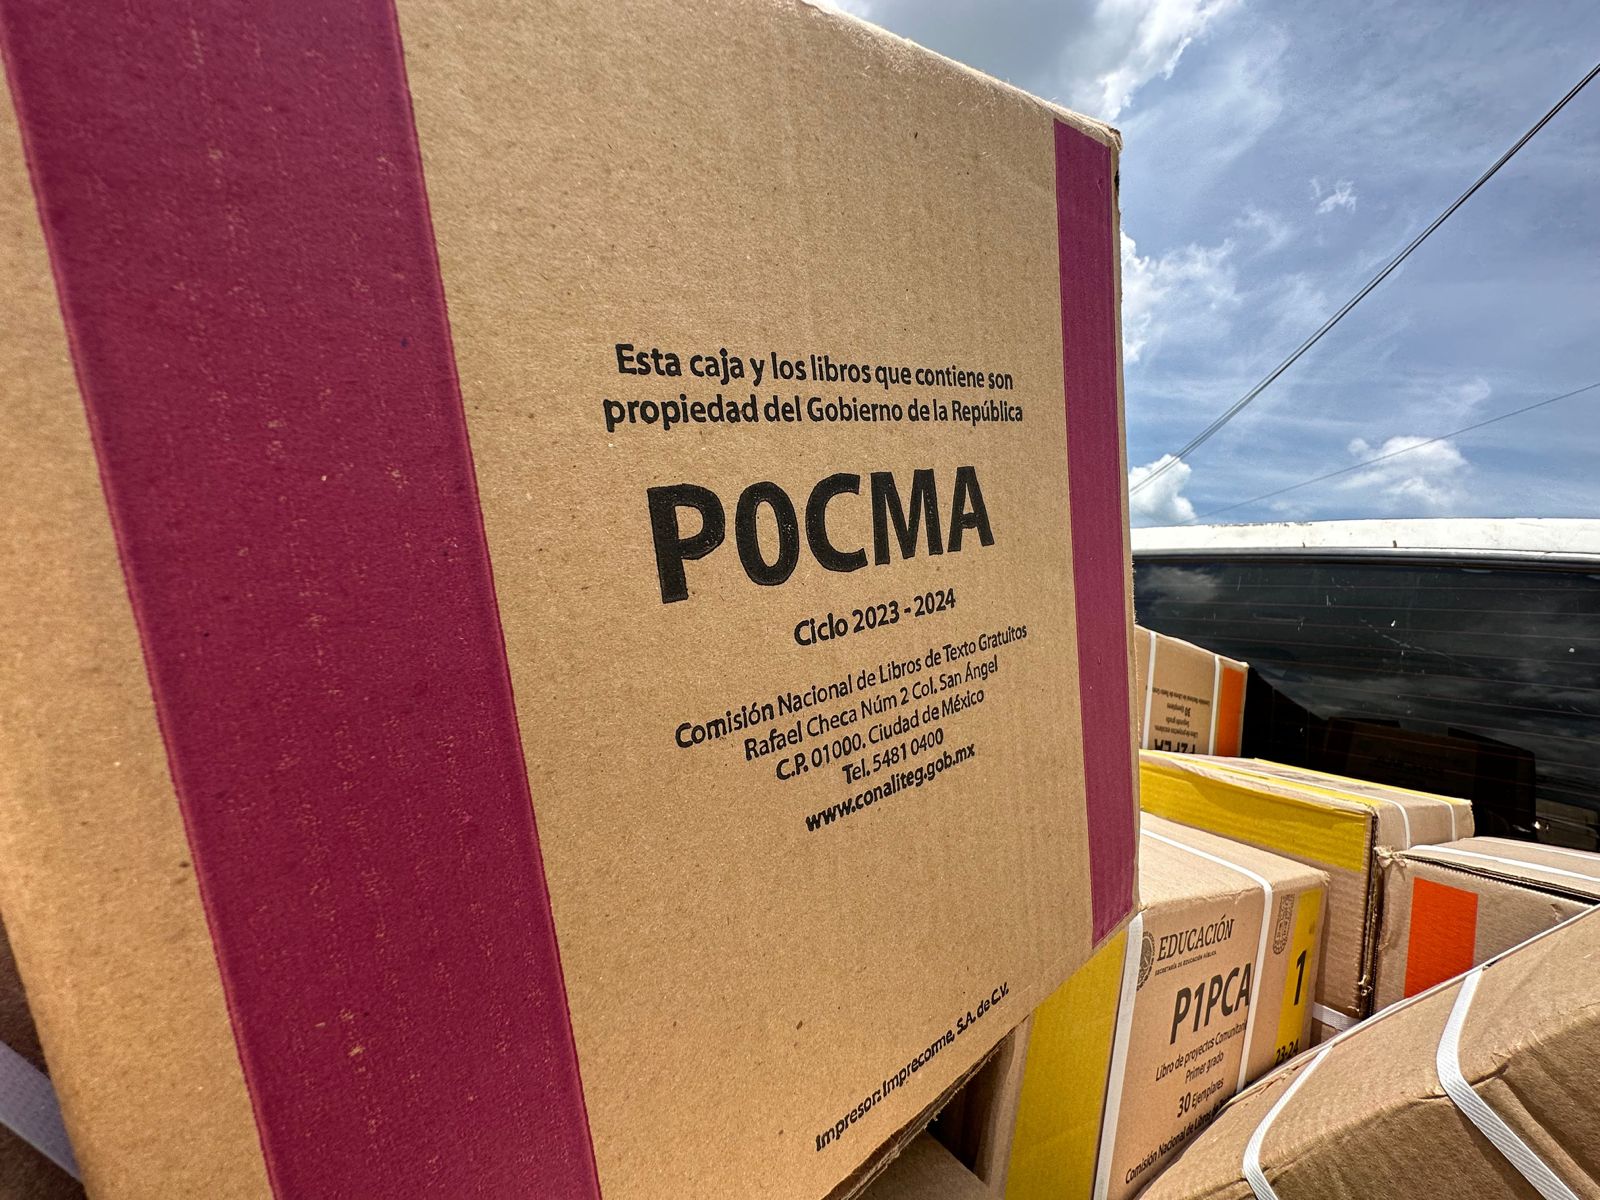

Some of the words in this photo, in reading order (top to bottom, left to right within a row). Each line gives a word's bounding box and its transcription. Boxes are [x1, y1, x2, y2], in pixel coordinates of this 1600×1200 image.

[615, 343, 681, 376] Esta
[690, 348, 745, 386] caja
[751, 357, 765, 386] y
[771, 351, 806, 381] los
[810, 354, 871, 384] libros
[875, 366, 911, 390] que
[915, 365, 985, 388] contiene
[988, 373, 1013, 390] son
[603, 393, 758, 432] propiedad
[764, 395, 800, 422] del
[807, 396, 902, 422] Gobierno
[907, 398, 929, 422] de
[933, 399, 948, 421] la
[952, 398, 1023, 426] República
[794, 613, 848, 646] Ciclo
[852, 600, 900, 634] 2023
[914, 587, 957, 618] 2024
[674, 702, 775, 749] Comisión
[777, 674, 853, 717] Nacional
[856, 666, 876, 690] de
[879, 654, 922, 683] Libros
[924, 648, 941, 669] de
[943, 637, 976, 663] Texto
[978, 624, 1028, 651] Gratuitos
[743, 723, 803, 761] Rafael
[807, 708, 858, 738] Checa
[860, 693, 898, 720] Núm
[900, 687, 910, 706] 2
[912, 678, 938, 702] Col.
[939, 670, 962, 690] San
[964, 655, 999, 684] Ángel
[775, 752, 809, 781] C.P.
[811, 736, 866, 768] 01000.
[868, 712, 919, 745] Ciudad
[922, 705, 939, 724] de
[941, 689, 985, 719] México
[842, 763, 871, 785] Tel.
[872, 746, 907, 773] 5481
[910, 727, 944, 757] 0400
[805, 743, 976, 832] www.conaliteg.gob.mx
[1157, 913, 1235, 961] EDUCACIÓN
[1293, 950, 1307, 1006] 1
[815, 1089, 882, 1152] Impresor:
[976, 998, 990, 1018] de
[1155, 1063, 1174, 1082] Libro
[1174, 1053, 1184, 1070] de
[1184, 1038, 1214, 1067] proyectos
[1185, 1063, 1206, 1084] Primer
[1206, 1050, 1224, 1073] grado
[1177, 1092, 1192, 1118] 30
[1192, 1078, 1224, 1109] Ejemplares
[1125, 1150, 1157, 1184] Comisión
[1158, 1126, 1187, 1159] Nacional
[1186, 1122, 1194, 1137] de
